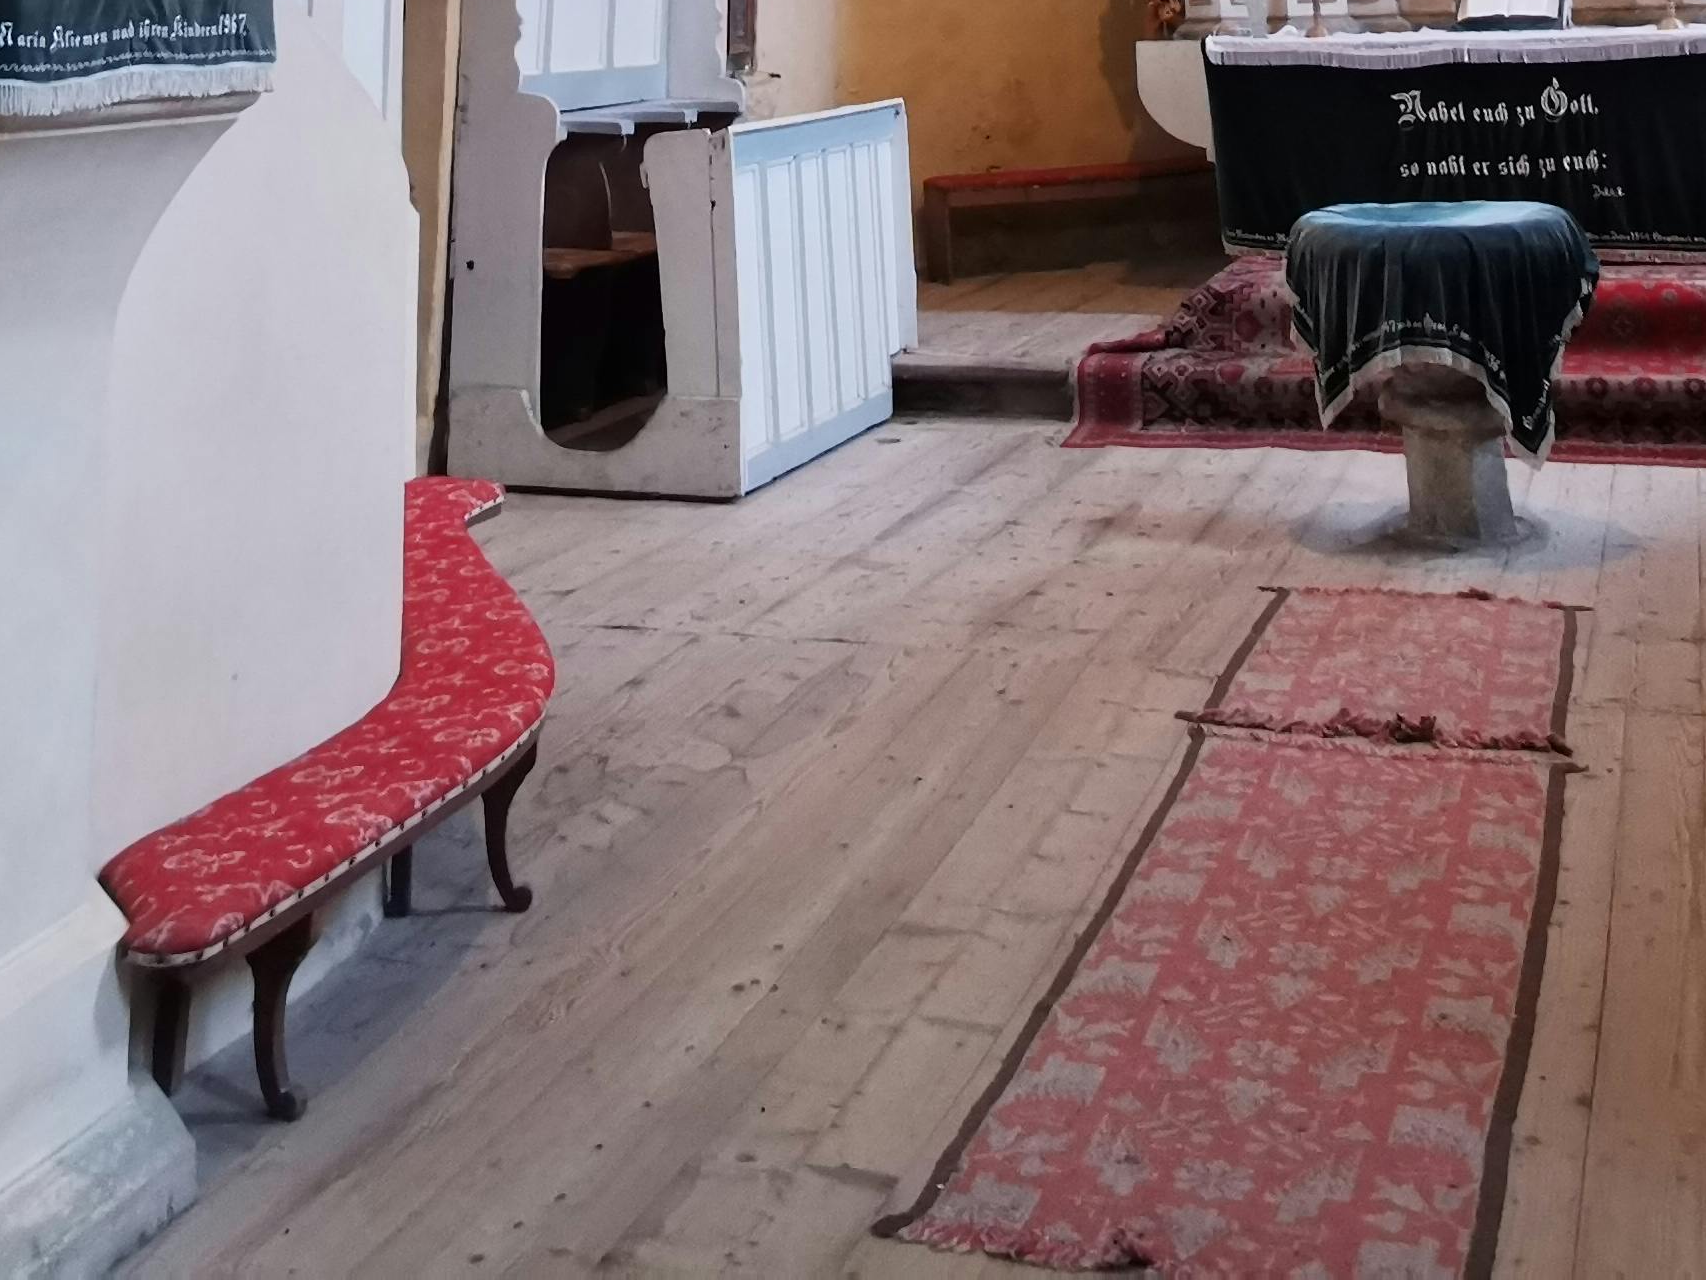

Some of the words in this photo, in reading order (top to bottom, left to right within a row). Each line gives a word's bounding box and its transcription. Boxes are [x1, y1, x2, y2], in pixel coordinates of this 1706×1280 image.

[1471, 101, 1510, 127] euch
[1515, 104, 1536, 128] zu
[1398, 160, 1421, 179] so
[1425, 154, 1467, 177] naht
[1471, 160, 1491, 177] er
[1497, 153, 1531, 178] sich
[1537, 156, 1557, 180] zu
